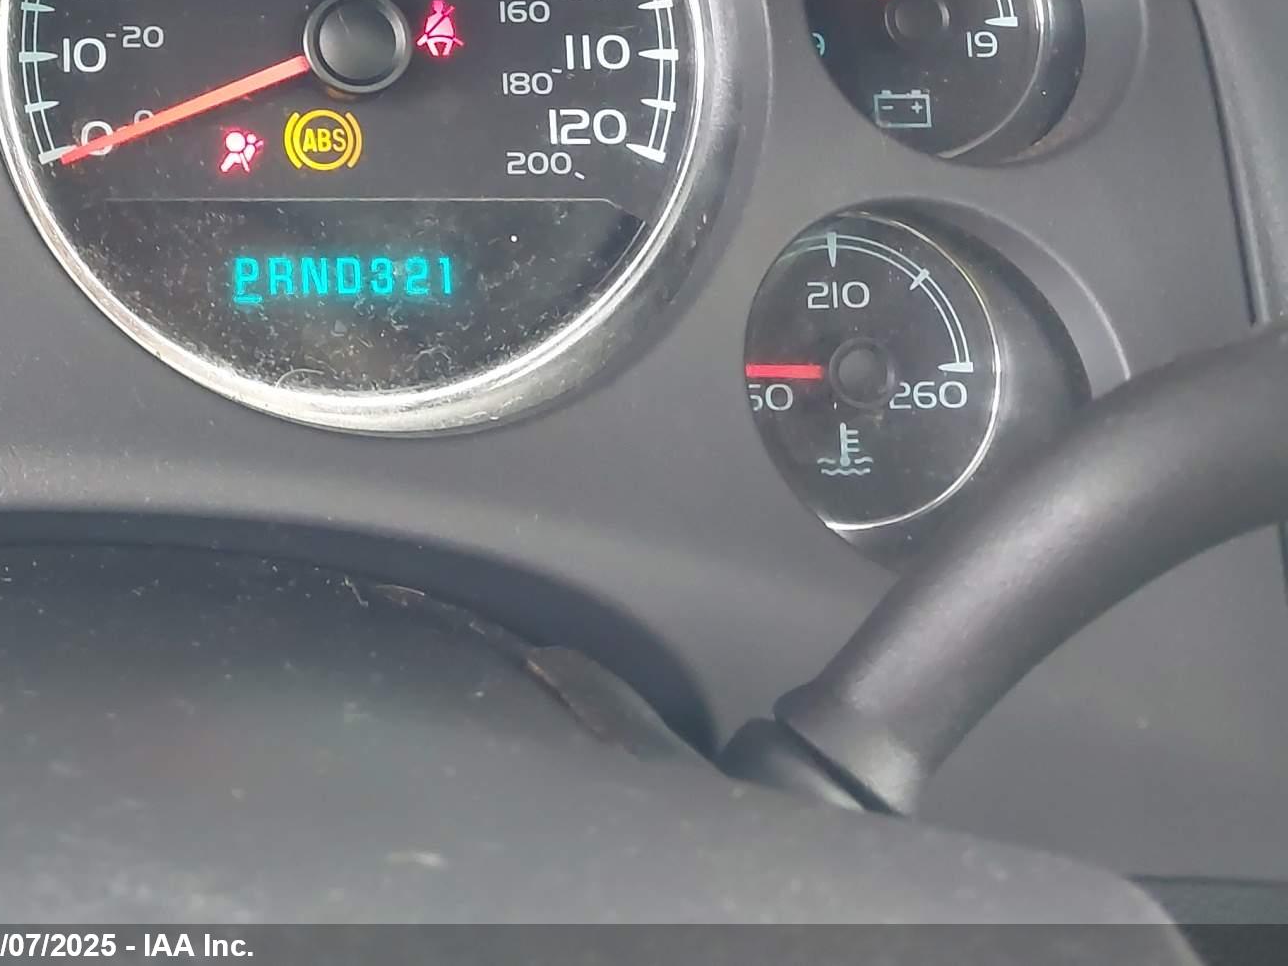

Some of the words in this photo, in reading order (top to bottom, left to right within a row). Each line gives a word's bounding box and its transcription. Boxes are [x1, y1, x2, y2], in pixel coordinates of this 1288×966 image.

[499, 1, 550, 24] 160
[121, 27, 164, 50] 20
[966, 32, 998, 59] 19
[62, 38, 107, 73] 10
[565, 35, 631, 70] 110
[501, 72, 553, 96] 180
[302, 126, 346, 153] ABS
[549, 108, 627, 146] 120
[506, 151, 572, 176] 200
[807, 281, 870, 310] 210
[889, 381, 968, 409] 260
